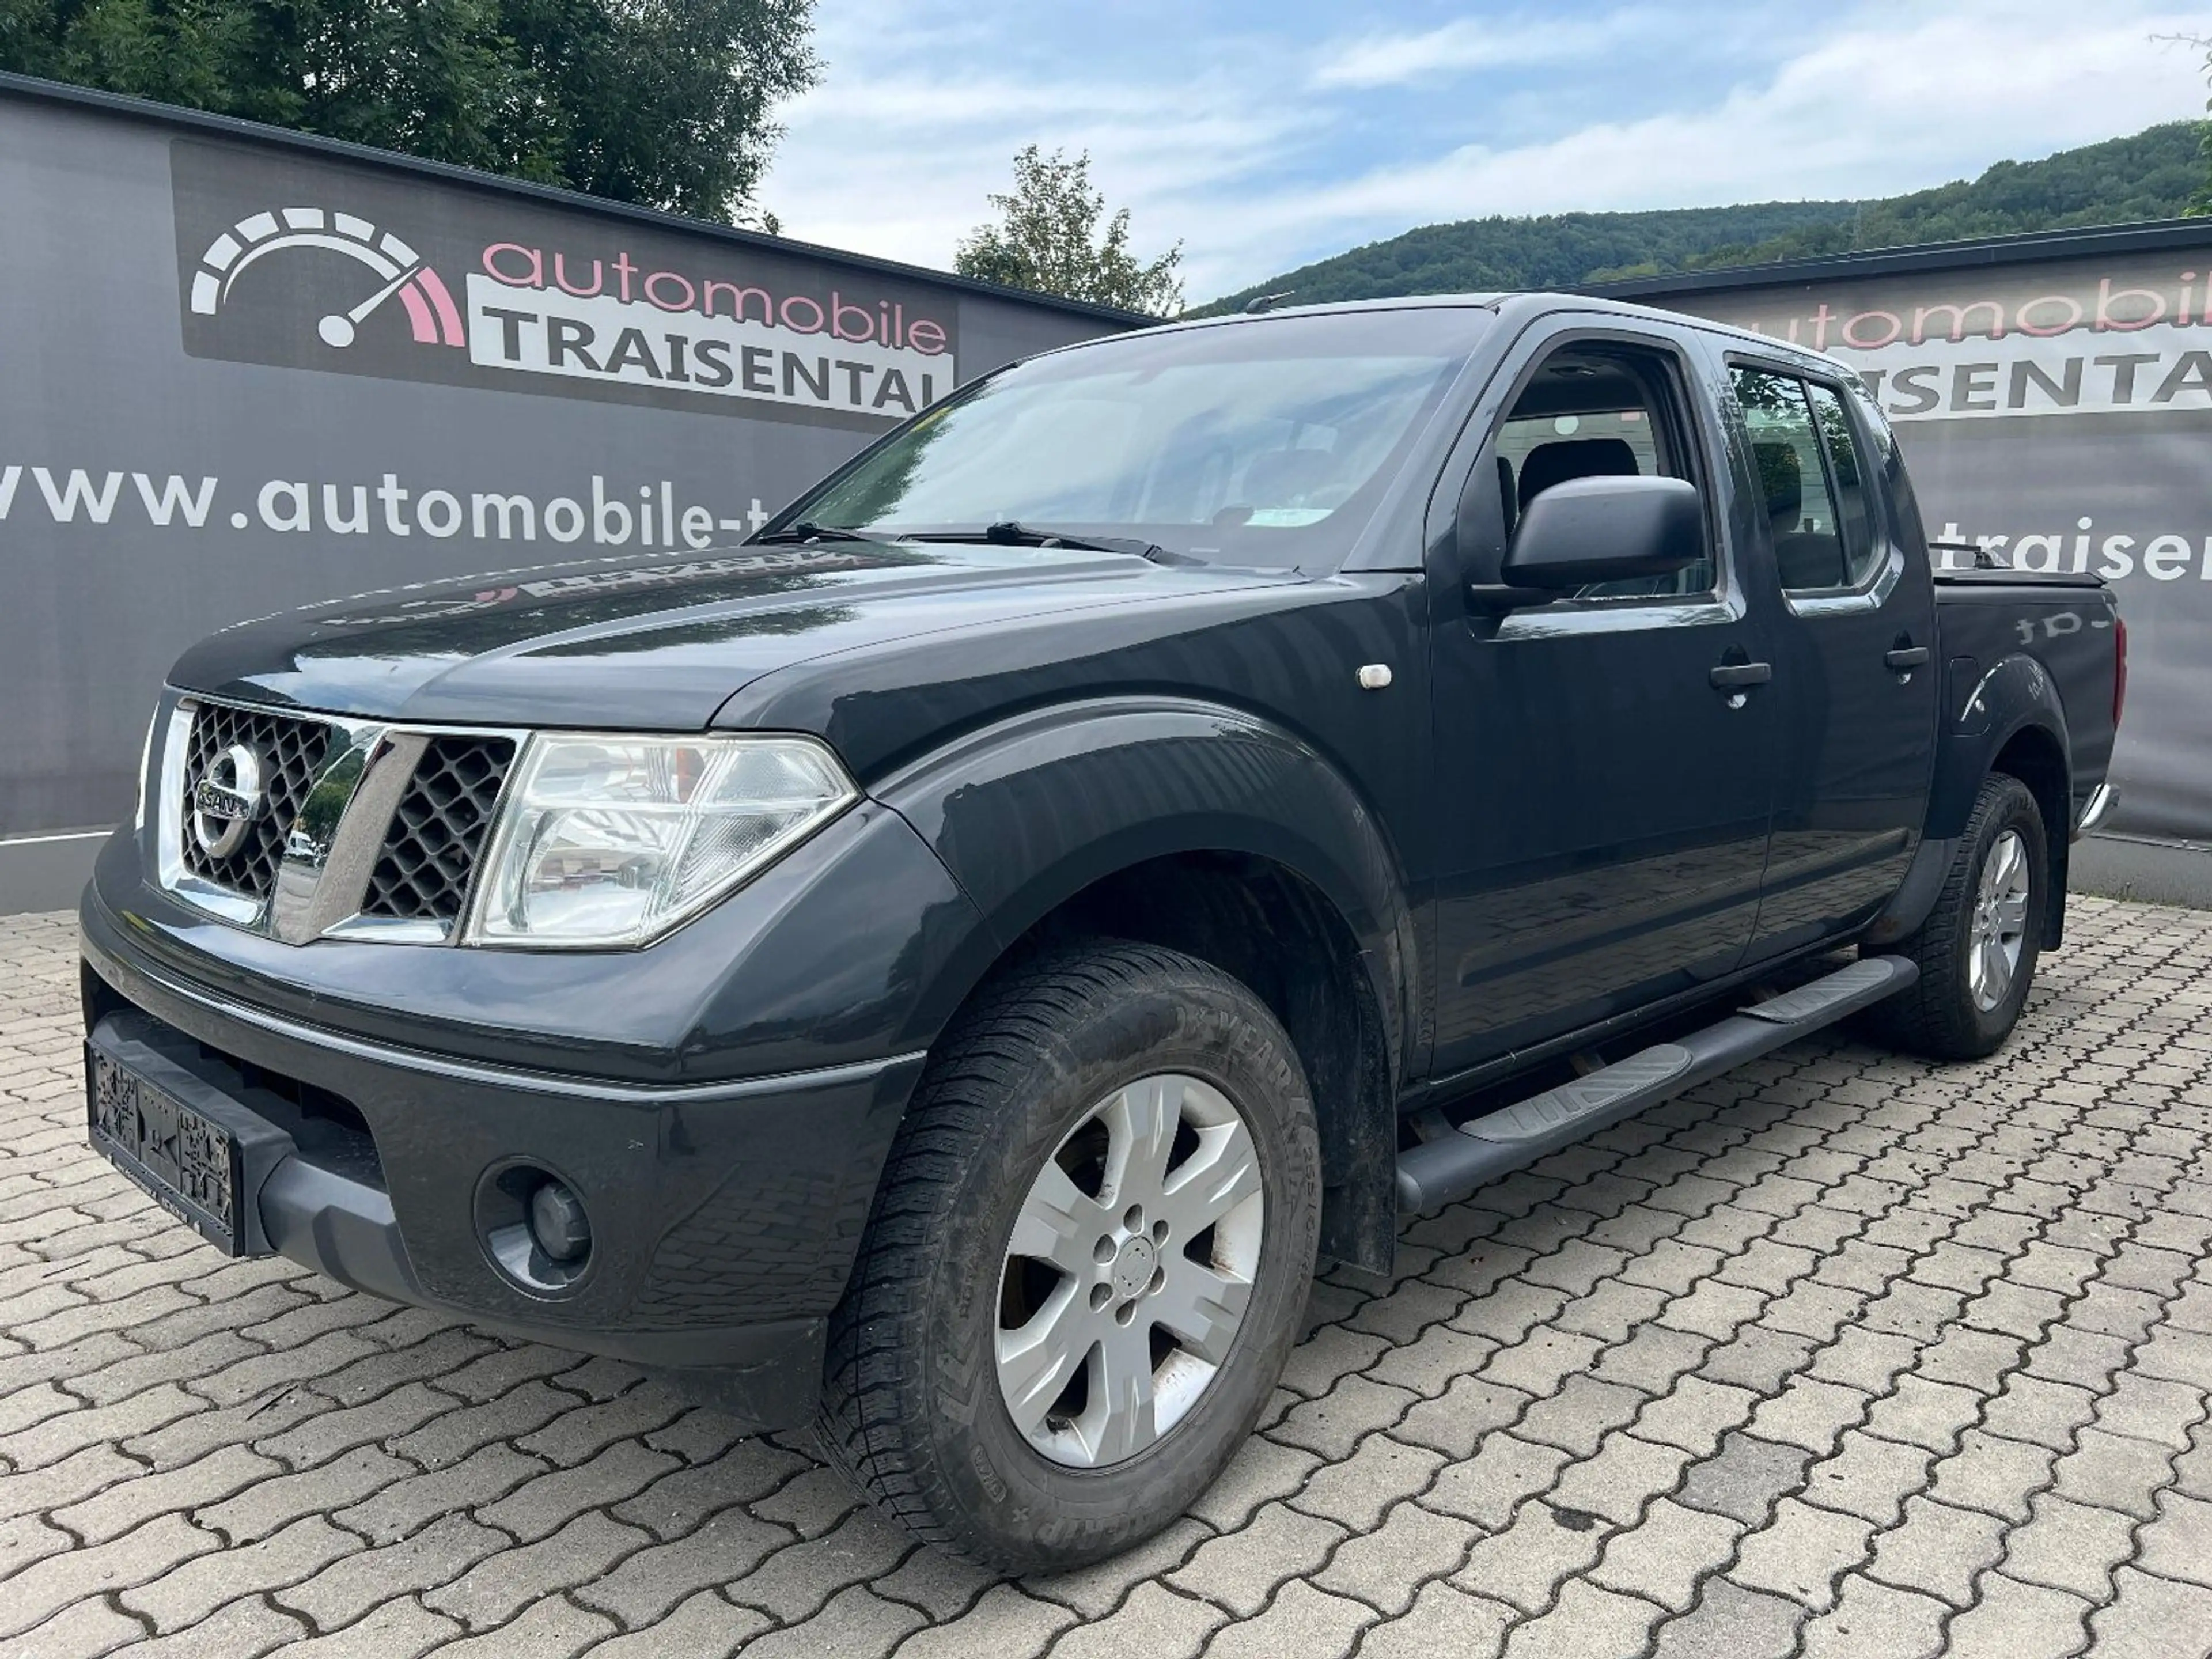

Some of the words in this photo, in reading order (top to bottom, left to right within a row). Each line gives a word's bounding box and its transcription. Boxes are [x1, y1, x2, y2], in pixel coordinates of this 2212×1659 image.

[482, 243, 946, 353] automobile
[1751, 271, 2212, 351] tomobil
[0, 465, 768, 548] ww.automobile-t
[1938, 517, 2212, 580] traise
